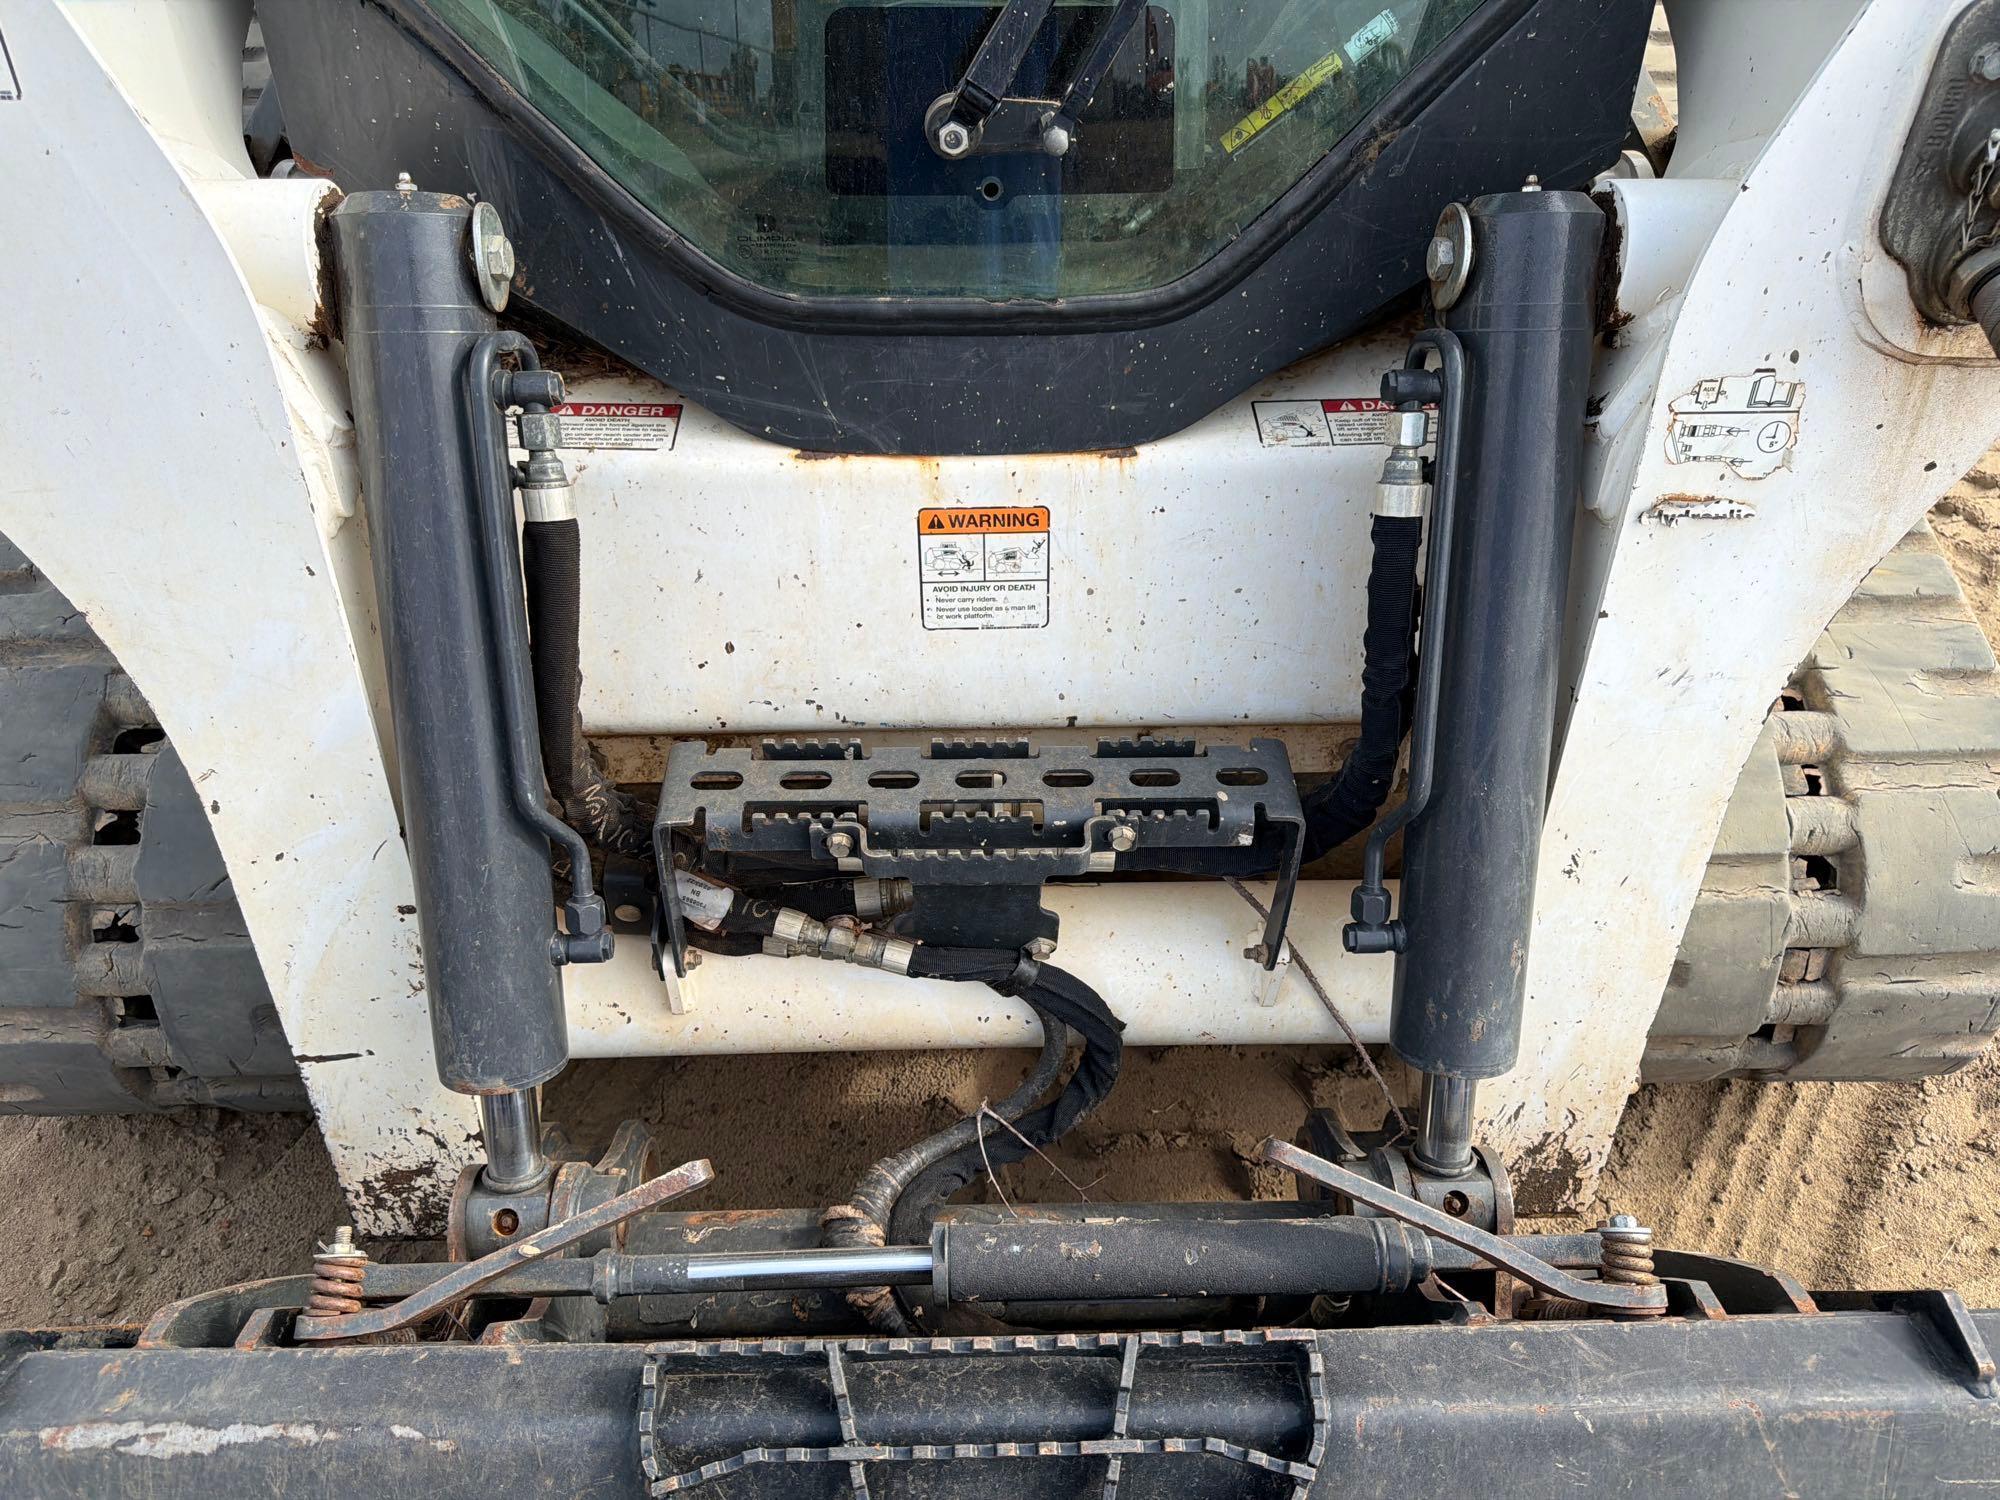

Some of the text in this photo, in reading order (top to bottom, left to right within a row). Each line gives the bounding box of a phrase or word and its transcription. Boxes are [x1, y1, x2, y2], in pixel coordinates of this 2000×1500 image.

[581, 405, 665, 416] DANGER
[948, 512, 1040, 529] WARNING
[963, 612, 995, 620] platform.
